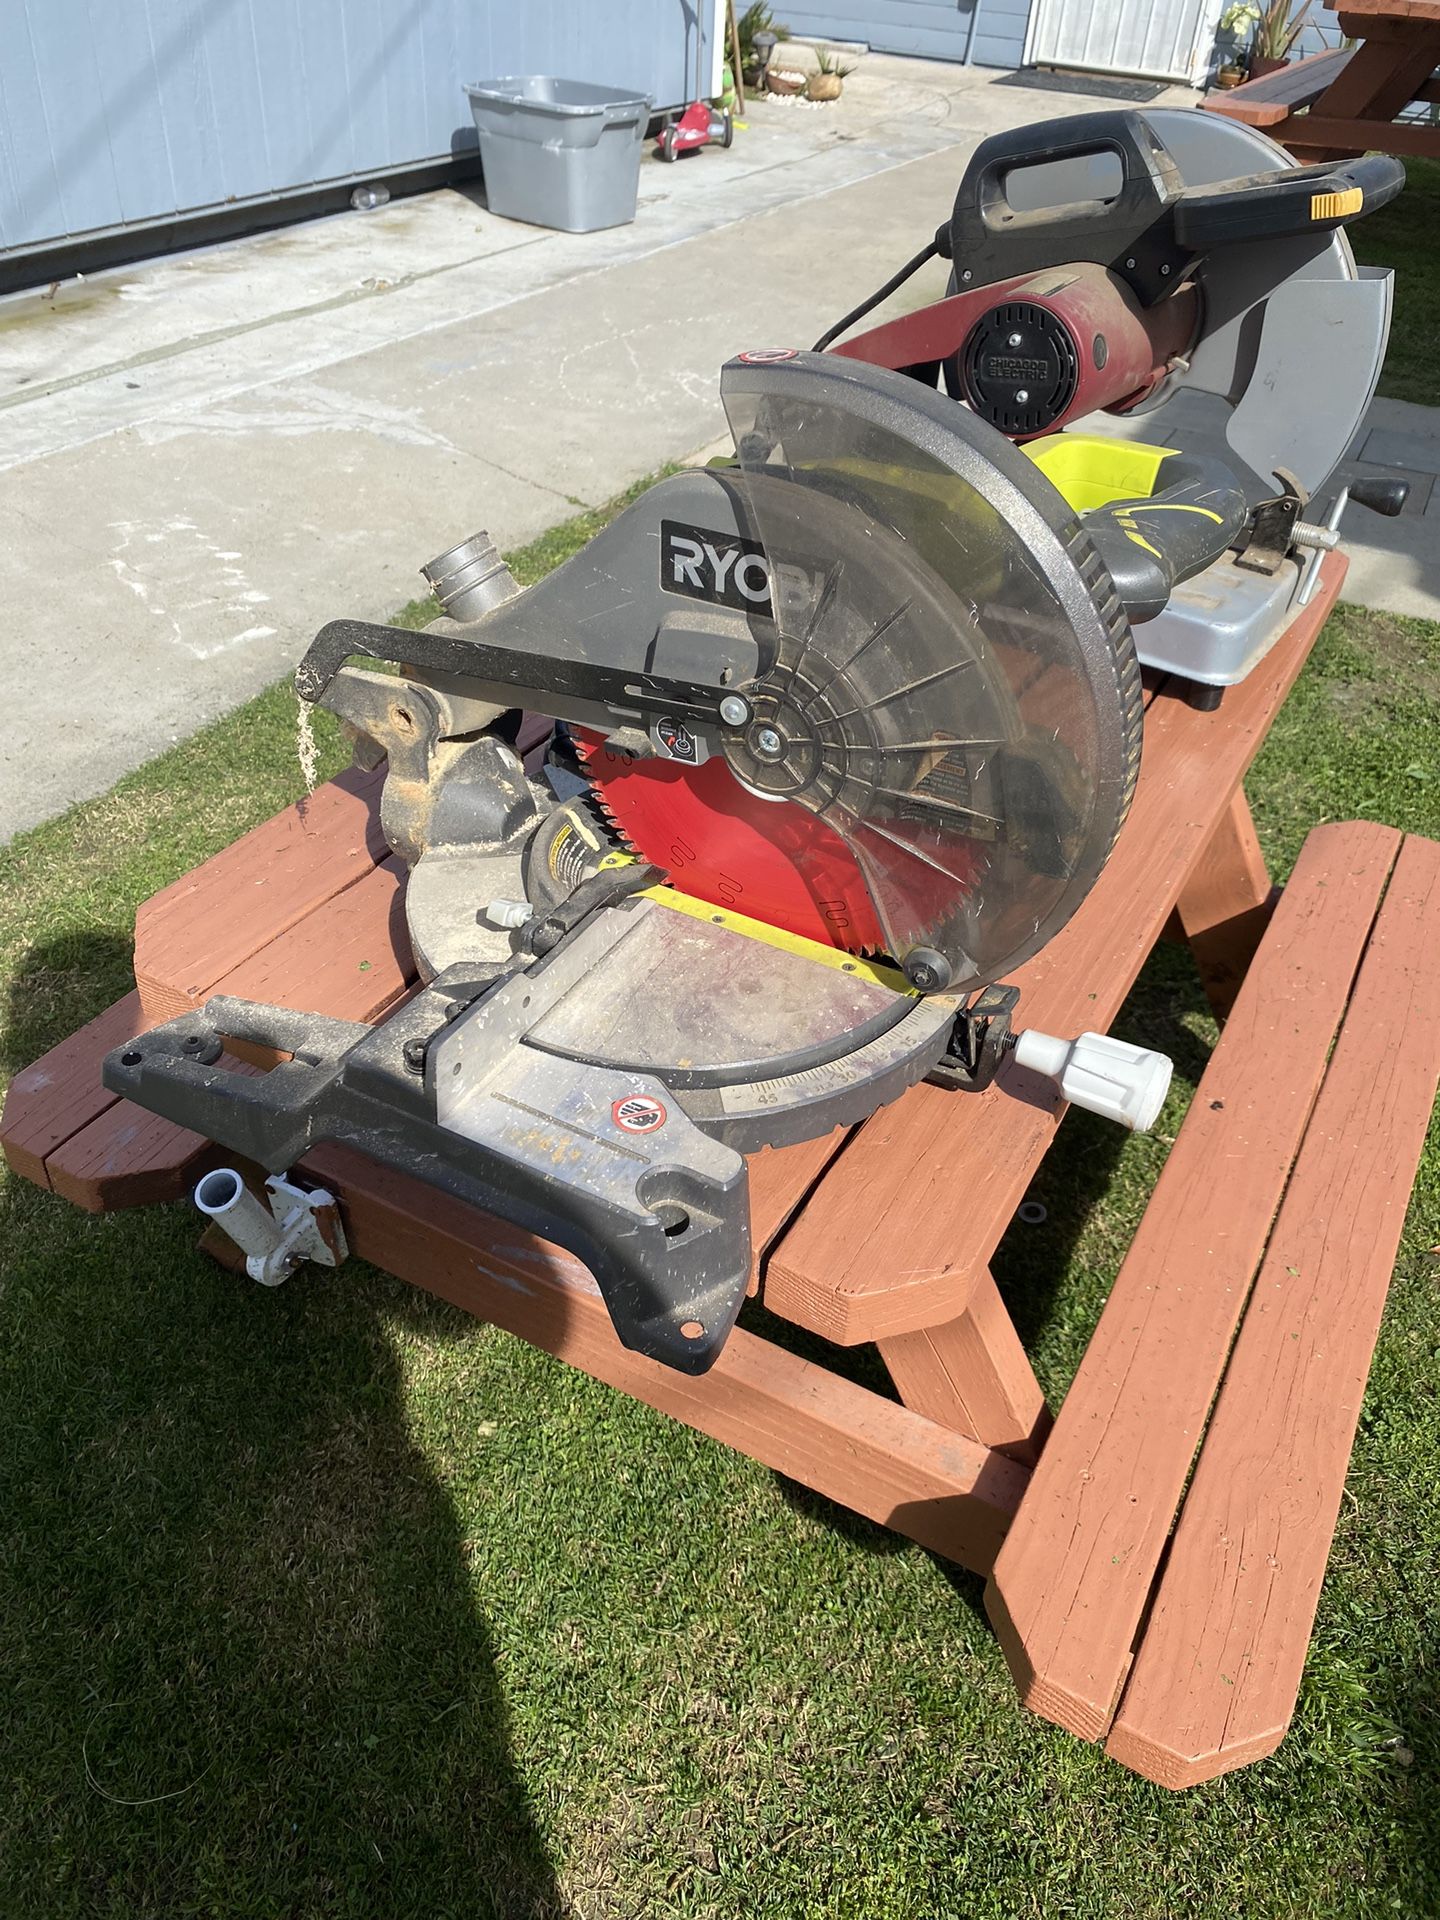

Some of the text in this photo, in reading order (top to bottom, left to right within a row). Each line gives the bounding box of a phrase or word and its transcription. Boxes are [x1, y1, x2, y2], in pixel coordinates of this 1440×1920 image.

[989, 357, 1040, 369] CHICAGO
[989, 367, 1048, 380] ELECTRIC
[757, 1092, 778, 1105] 45
